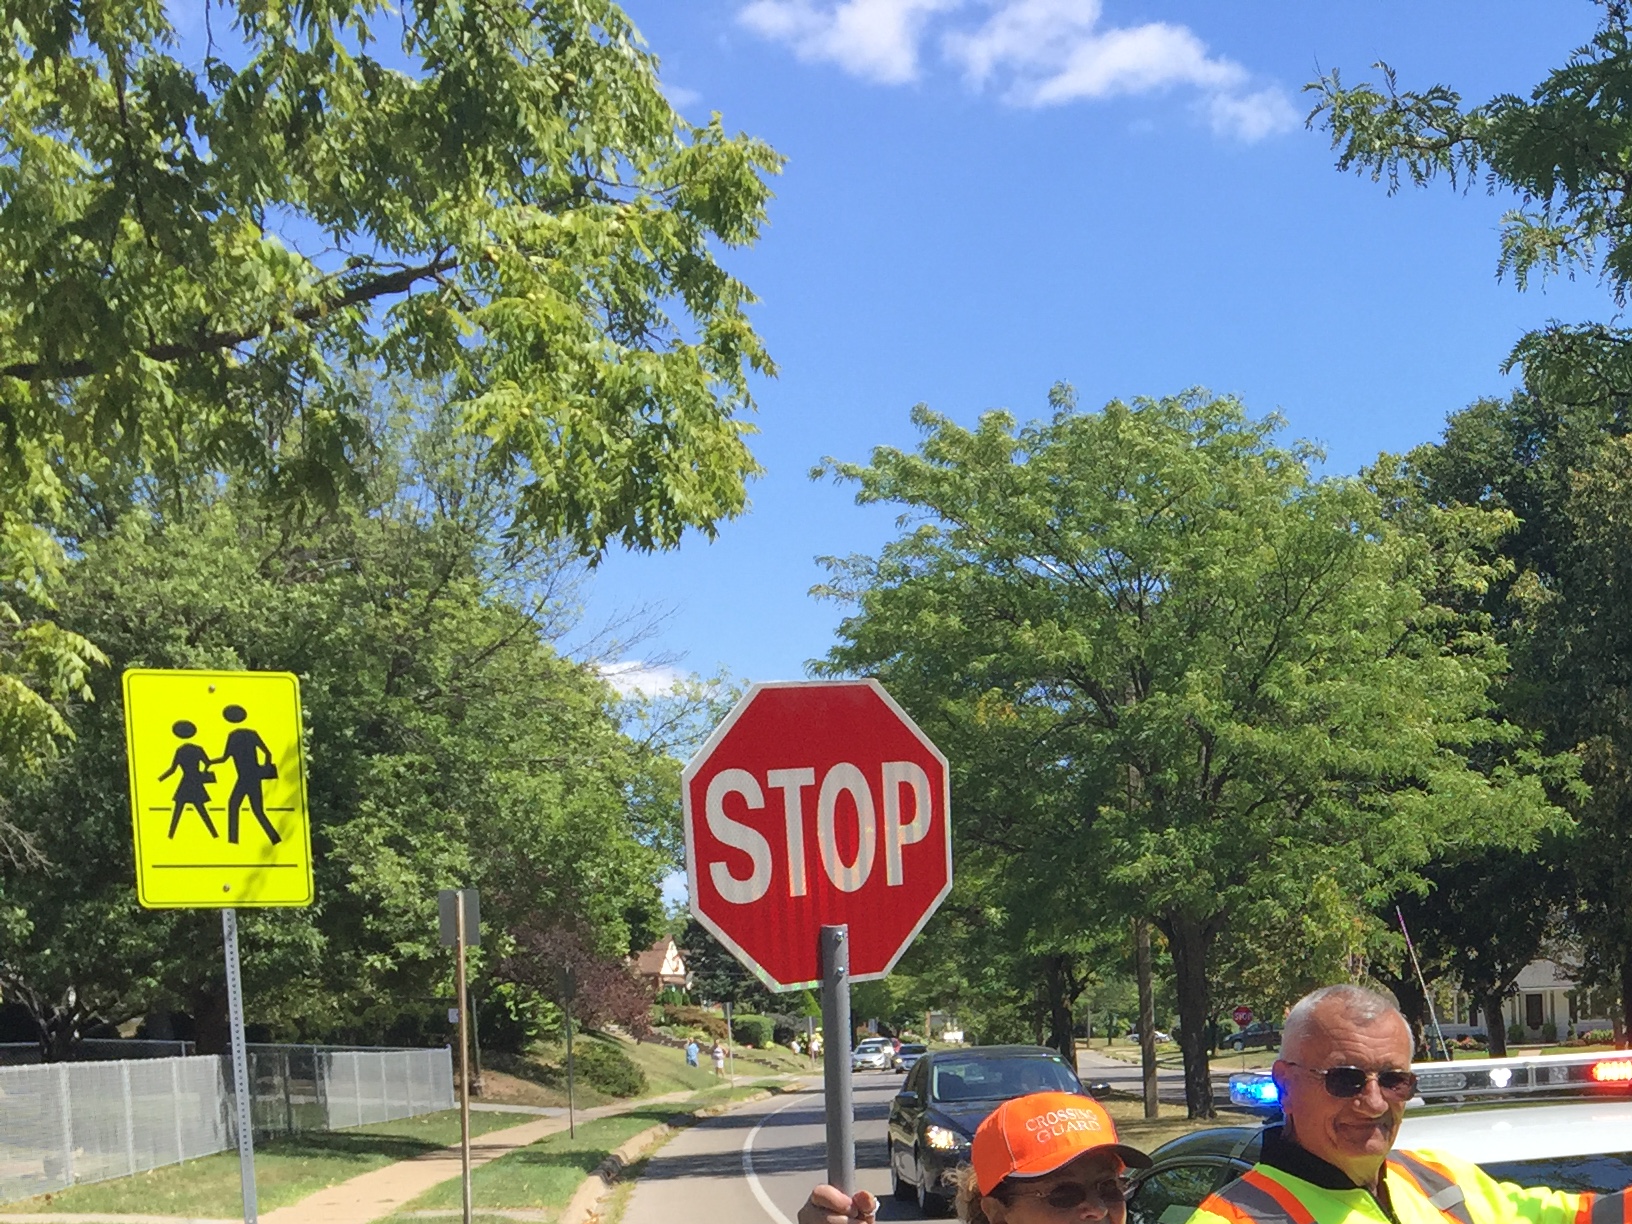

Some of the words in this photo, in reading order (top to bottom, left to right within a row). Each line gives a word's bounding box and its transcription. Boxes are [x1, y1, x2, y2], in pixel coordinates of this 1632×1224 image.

[705, 761, 932, 904] STOP
[1234, 1012, 1253, 1020] STOP
[1025, 1107, 1097, 1132] CROSSING
[1036, 1120, 1101, 1143] GUARD
